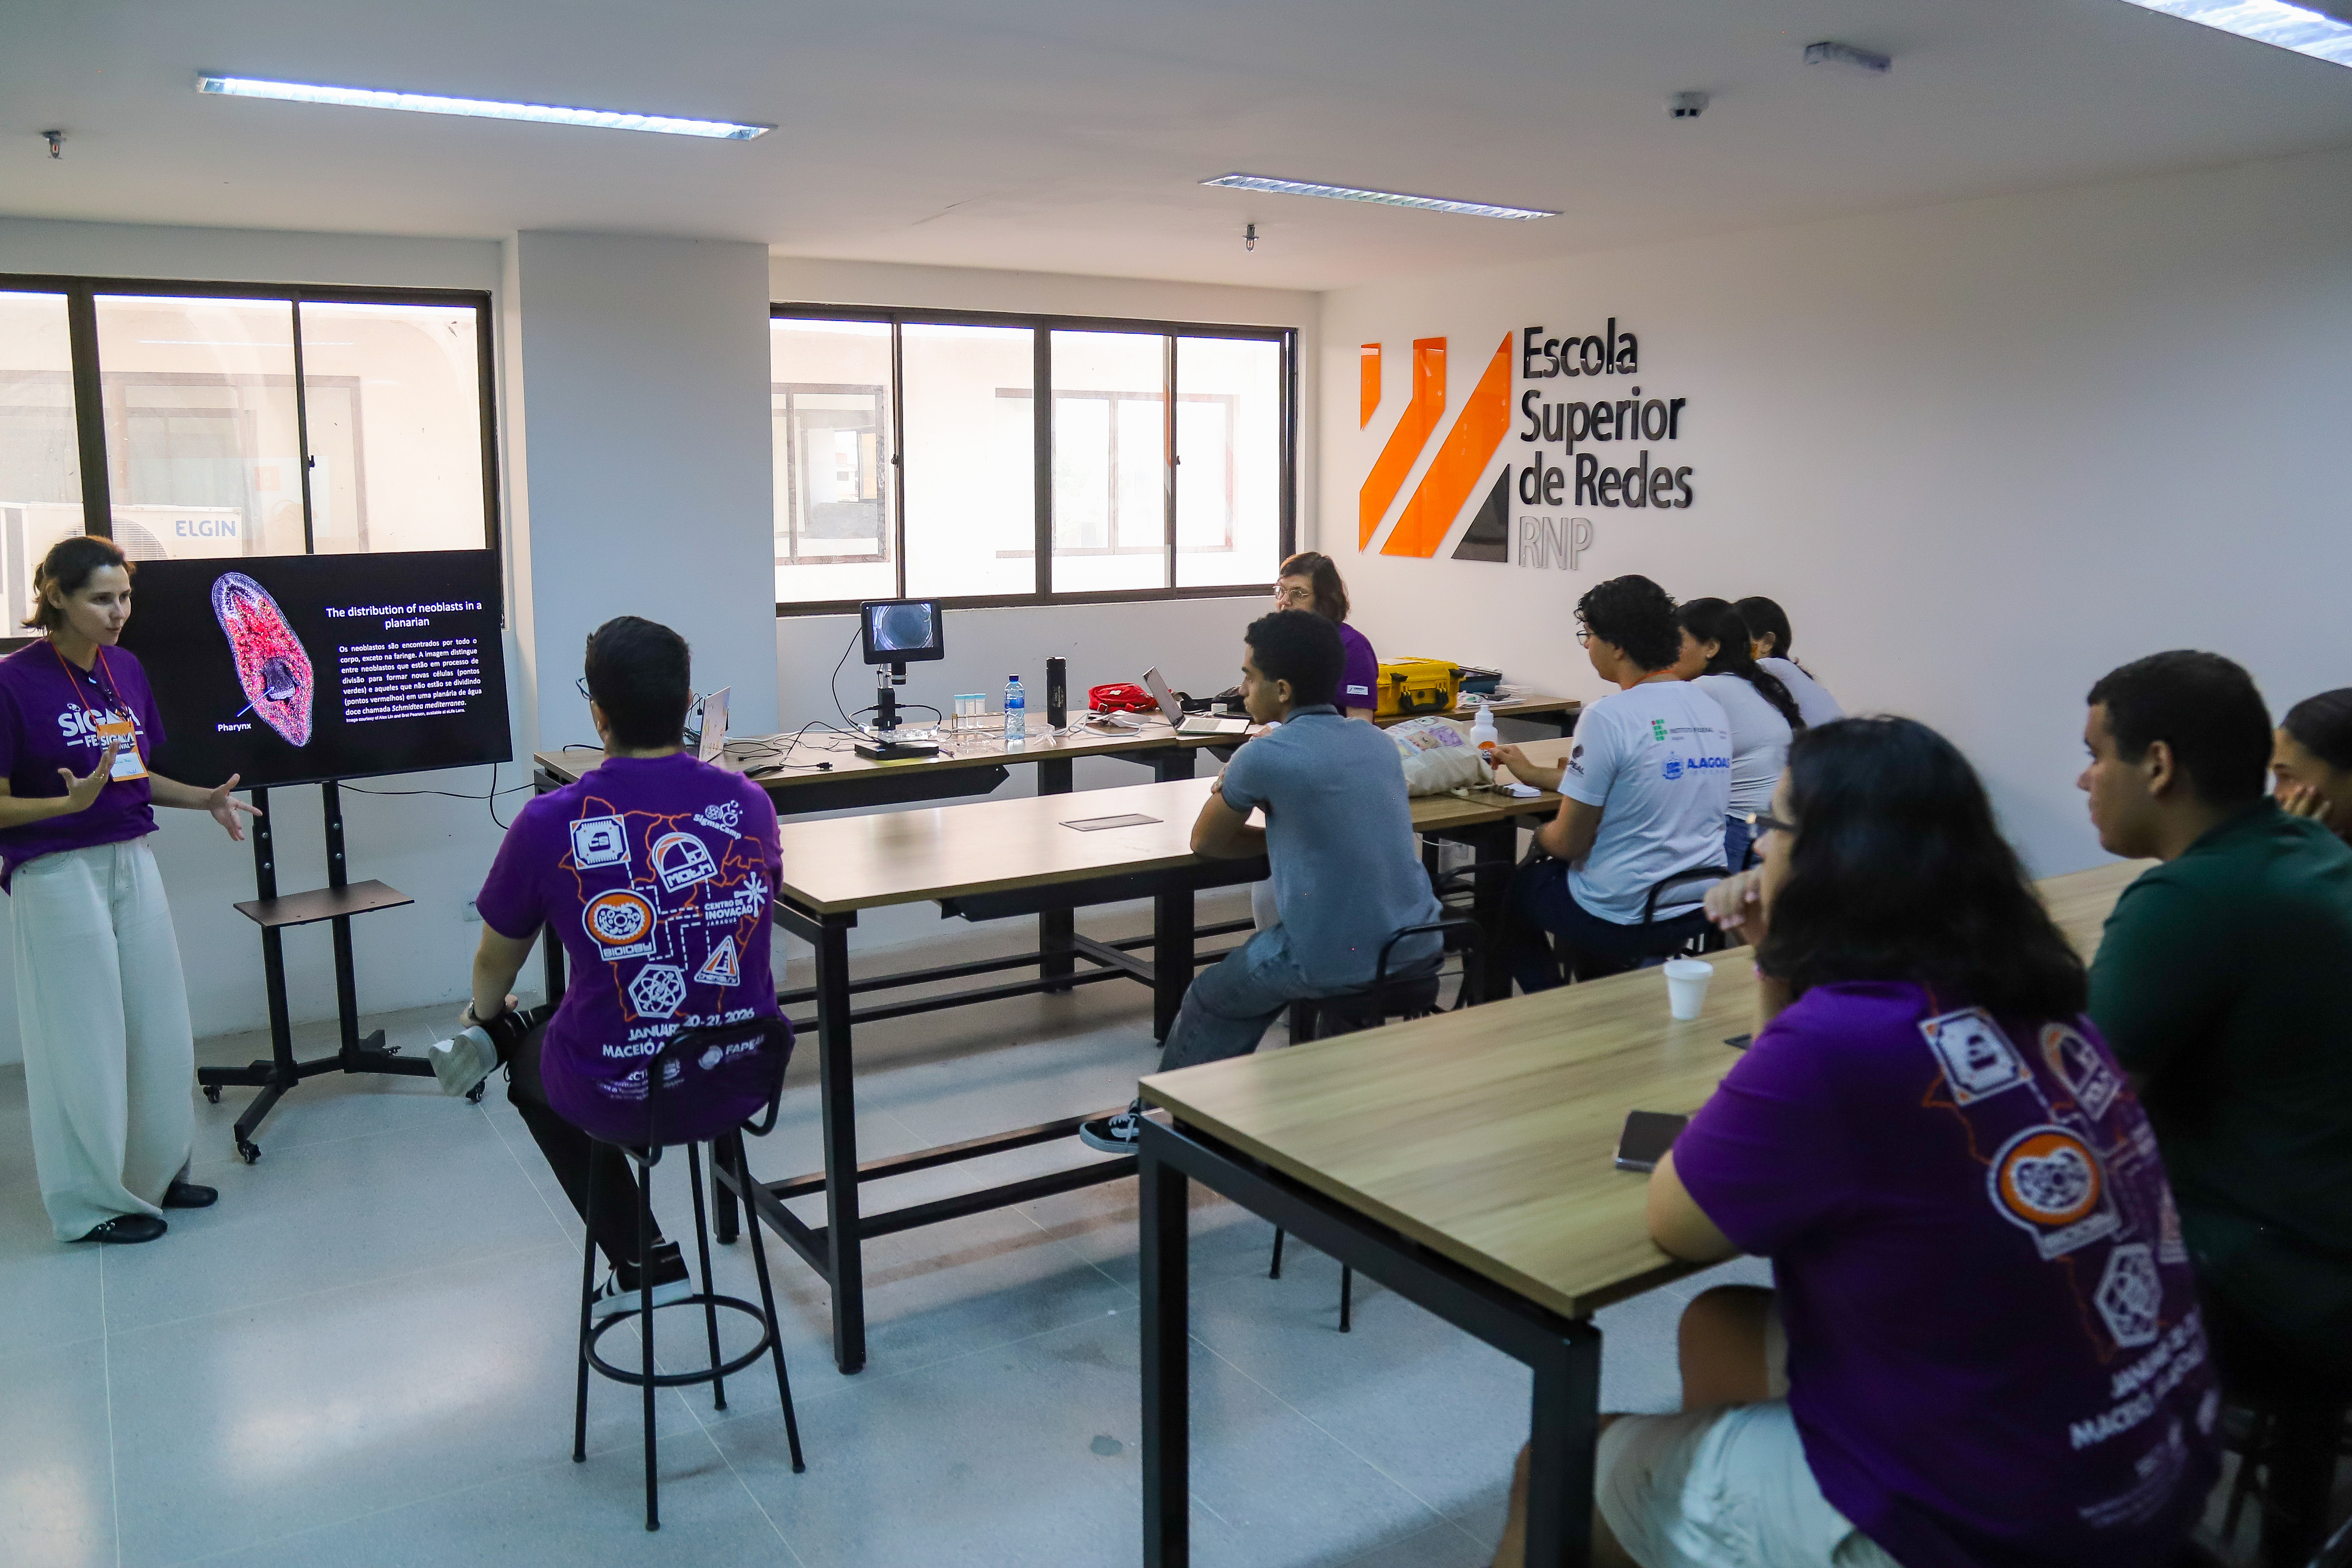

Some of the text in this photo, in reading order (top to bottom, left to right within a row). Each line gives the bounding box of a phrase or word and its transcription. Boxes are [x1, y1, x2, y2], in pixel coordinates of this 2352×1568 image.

[1523, 317, 1638, 379] Escola
[1520, 386, 1686, 456] Superior
[1519, 450, 1693, 509] de Redes
[175, 520, 236, 537] ELGIN
[1519, 516, 1593, 570] RNP
[325, 607, 345, 617] The
[348, 605, 404, 616] distribution
[406, 603, 417, 613] of
[418, 602, 464, 612] neoblasts
[465, 601, 474, 610] in
[385, 617, 429, 630] planarian
[369, 694, 405, 702] vermelhos)
[433, 690, 457, 699] planária
[374, 684, 399, 693] aqueles
[362, 706, 391, 714] chamada
[392, 703, 423, 711] Schmidtea
[217, 720, 252, 732] Pharynx
[693, 813, 742, 840] SigmaCamp
[704, 899, 734, 911] CENTRO
[725, 1007, 755, 1024] 2026
[602, 1038, 655, 1058] MACEIÓ
